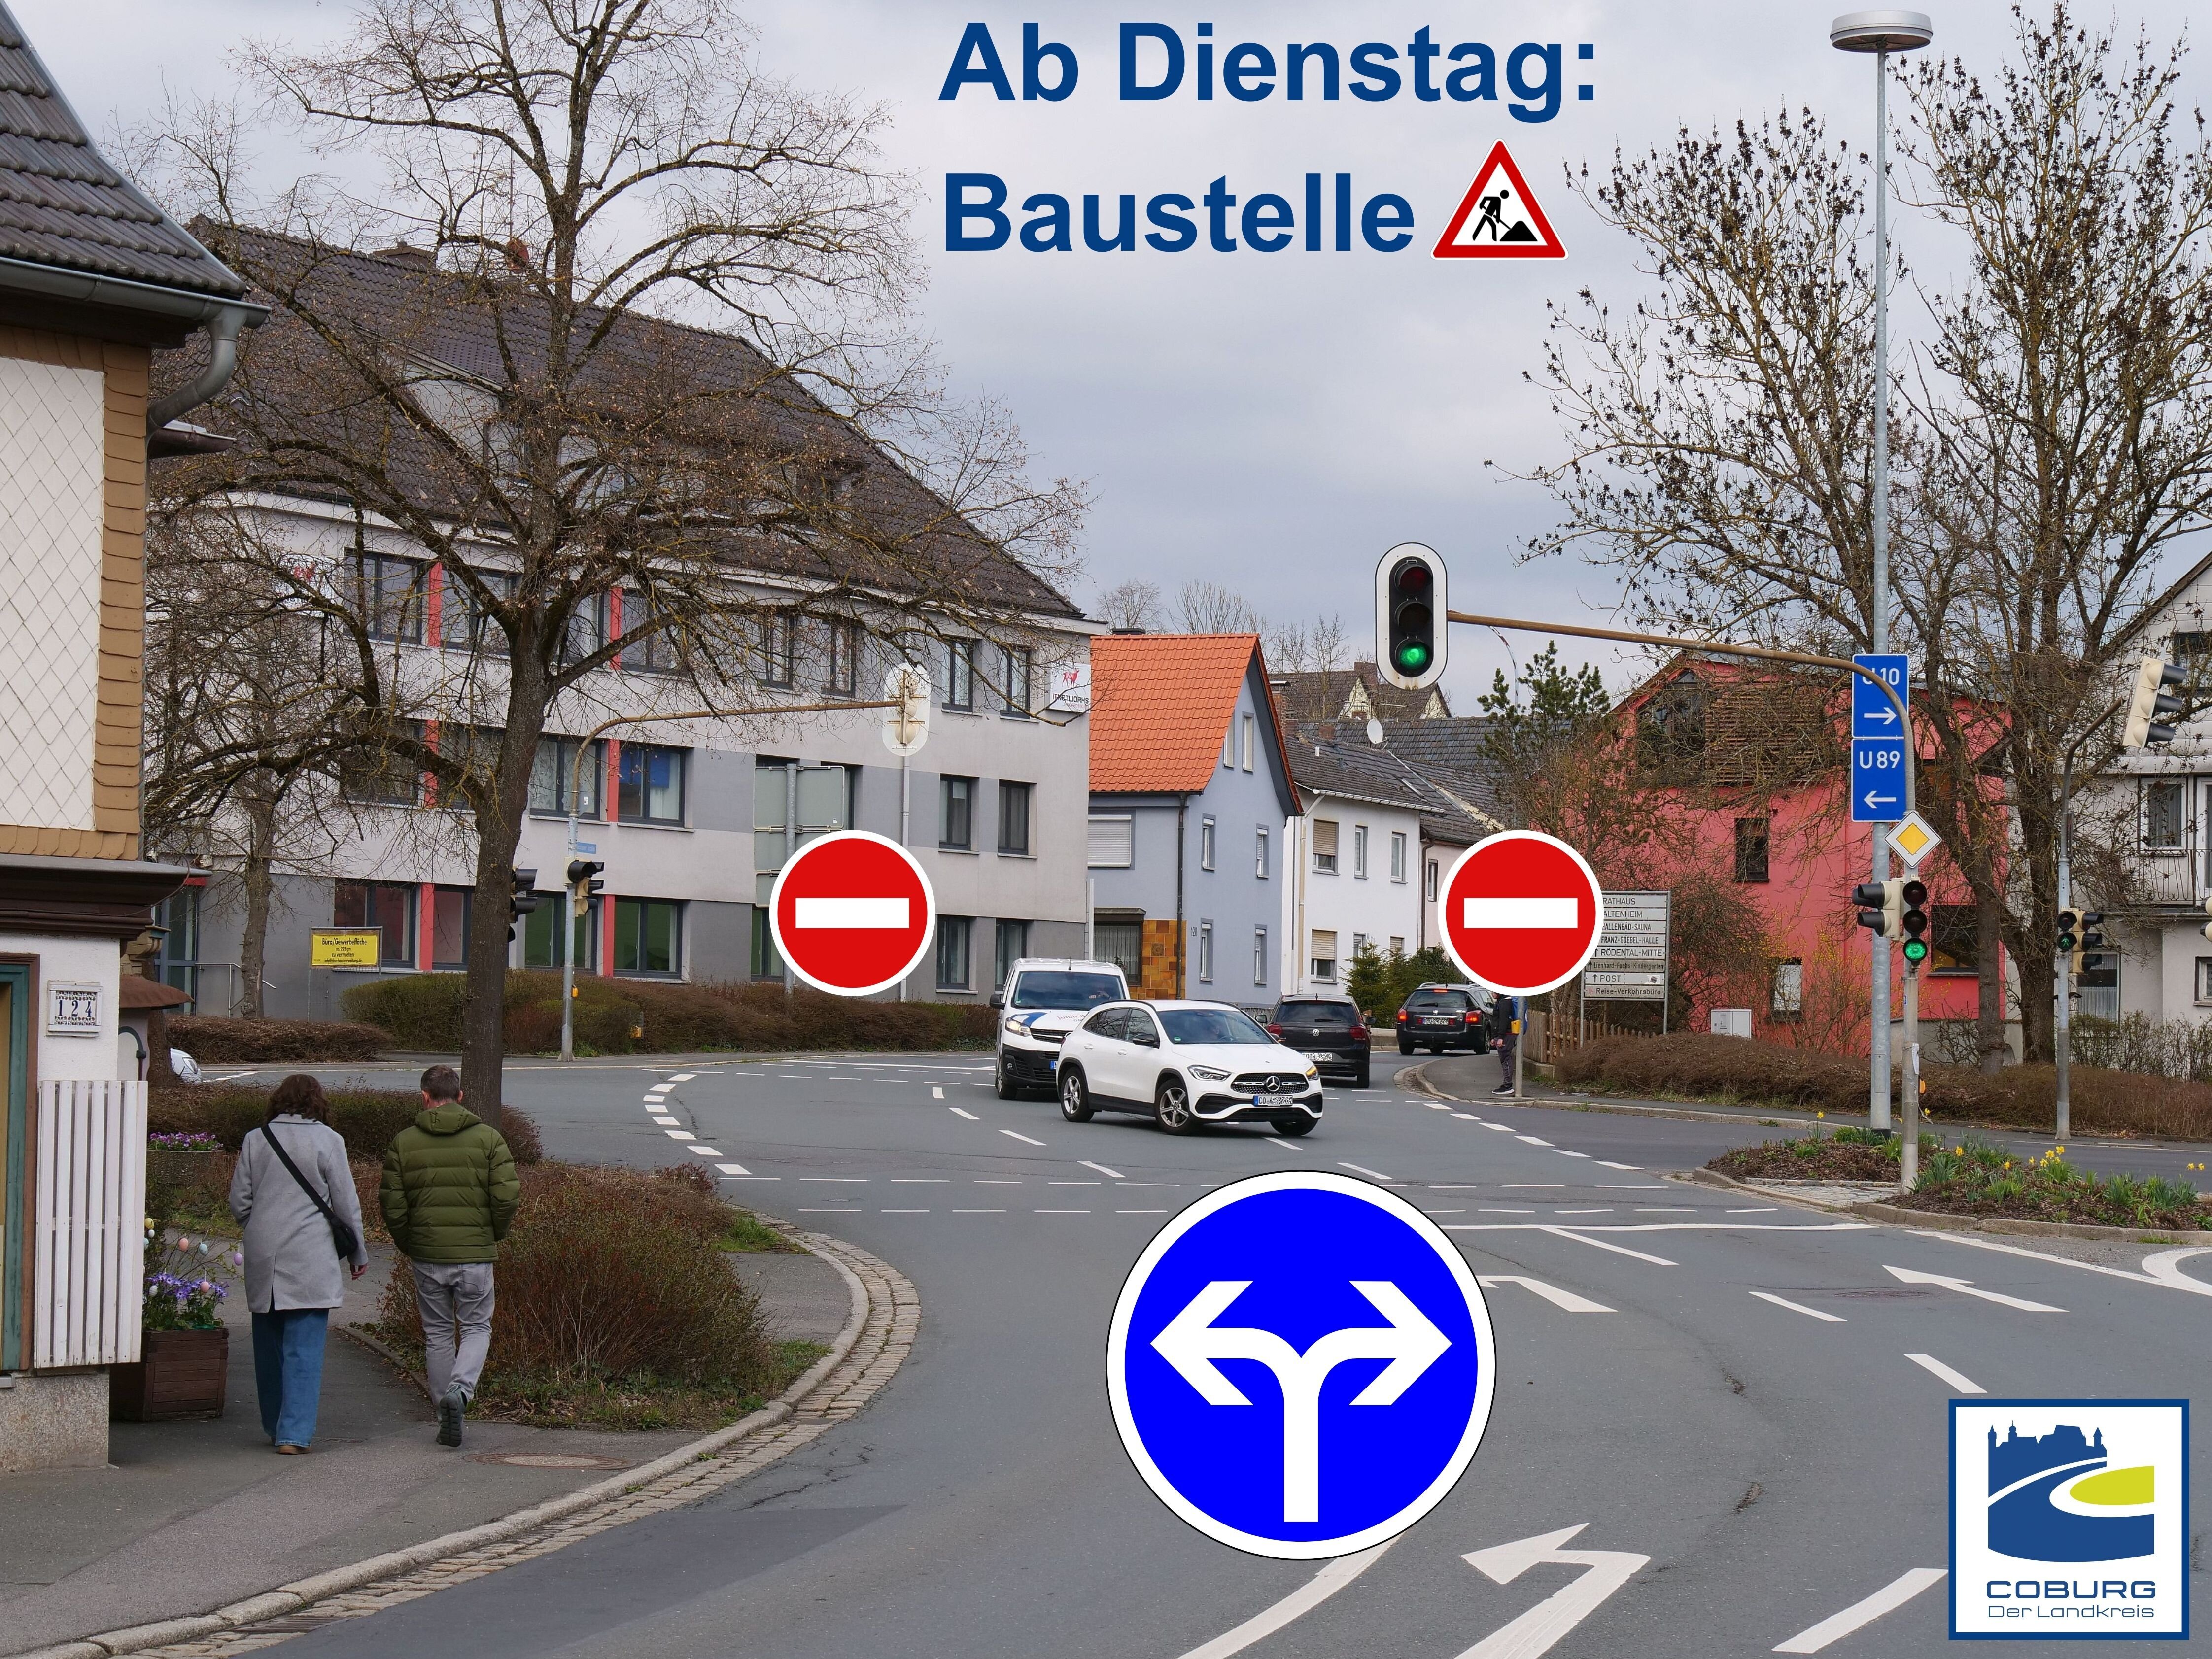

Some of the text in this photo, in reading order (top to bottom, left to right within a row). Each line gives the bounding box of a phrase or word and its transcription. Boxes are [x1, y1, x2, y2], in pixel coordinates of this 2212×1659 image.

[1880, 668, 1900, 685] 10
[1860, 751, 1900, 769] U 89
[1601, 948, 1662, 957] RÖDENTAL-MITTE
[58, 999, 92, 1017] 124
